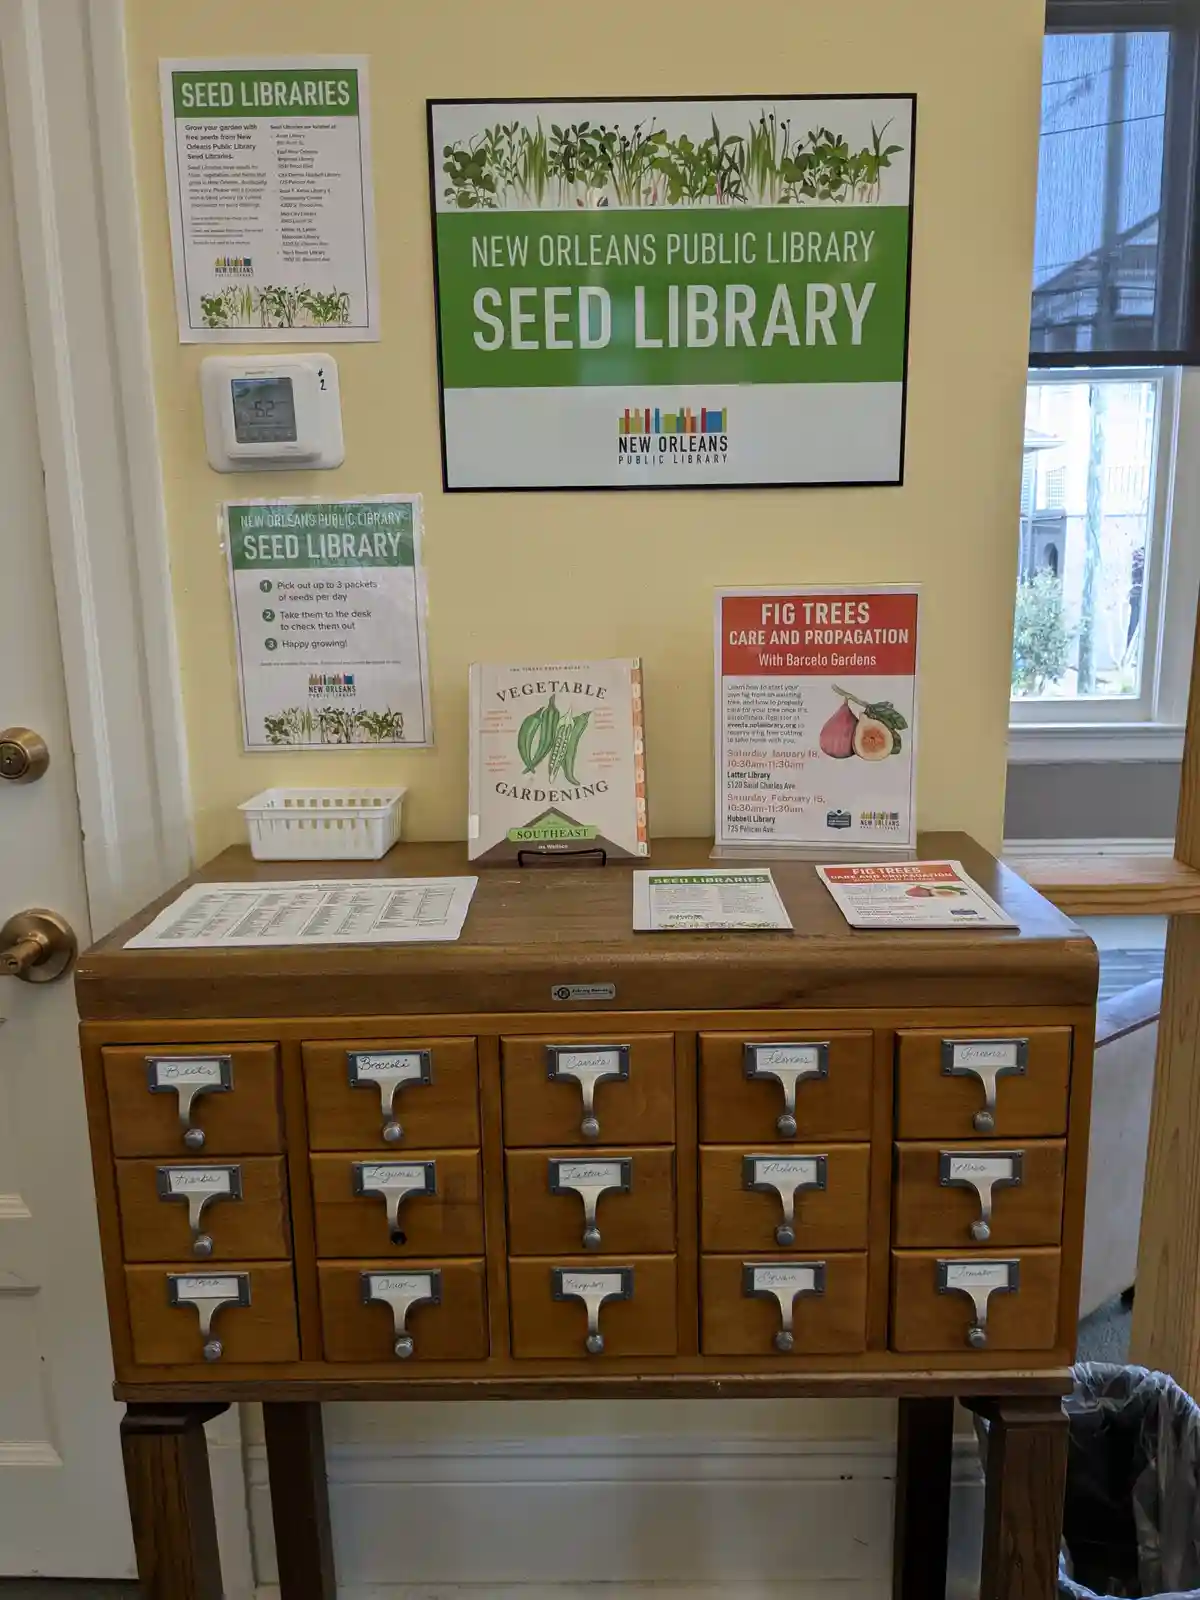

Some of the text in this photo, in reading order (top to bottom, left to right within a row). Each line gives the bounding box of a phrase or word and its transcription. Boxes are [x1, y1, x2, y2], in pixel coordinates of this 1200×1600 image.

[181, 80, 350, 107] SEED LIBRARIES
[203, 124, 218, 132] your
[219, 124, 242, 132] garden
[185, 133, 198, 141] free
[200, 133, 218, 141] seeds
[234, 143, 257, 151] Library
[472, 230, 875, 268] NEW ORLEANS PUBLIC LIBRARY
[473, 282, 876, 351] SEED LIBRARY
[618, 435, 728, 453] NEW ORLEANS
[618, 453, 728, 465] PUBLIC LIBRARY
[240, 512, 401, 528] NEW ORLEANS PUBLIC LIBRARY
[243, 532, 402, 560] SEED LIBRARY
[277, 581, 295, 590] Pick
[298, 582, 311, 590] out
[313, 582, 324, 592] up
[326, 581, 335, 590] to
[336, 580, 342, 589] 3
[344, 580, 378, 591] packets
[278, 592, 348, 603] of seeds per day
[280, 610, 300, 619] Take
[301, 610, 323, 619] them
[325, 610, 334, 618] to
[336, 610, 349, 618] the
[351, 610, 372, 618] desk
[761, 602, 870, 625] FIG TREES
[280, 622, 356, 631] to check them out
[729, 628, 909, 646] CARE AND PROPAGATION
[282, 640, 309, 650] Happy
[311, 639, 348, 650] growing!
[758, 652, 877, 667] With Barcelo Gardens
[325, 685, 356, 693] ORLEANS
[496, 680, 608, 702] VEGETABLE
[772, 749, 806, 759] January
[808, 750, 820, 759] 18,
[728, 760, 804, 770] 10:30am-11:30am
[727, 771, 770, 779] Latter Library
[495, 780, 609, 802] GARDENING
[727, 781, 743, 789] 5120
[760, 782, 783, 790] Charles
[771, 794, 810, 803] February
[813, 796, 826, 804] 15,
[728, 804, 804, 813] 10:30am-11:30am
[727, 815, 776, 824] Hubbell Library
[516, 828, 589, 840] SOUTHEAST
[727, 825, 738, 833] 725
[740, 825, 761, 833] Pelican
[692, 876, 766, 884] LIBRARIES
[961, 1046, 1008, 1061] Greens
[358, 1056, 410, 1070] Broccoli
[164, 1064, 217, 1078] Beets
[562, 1167, 611, 1180] Lettuce
[764, 1163, 809, 1175] Melons
